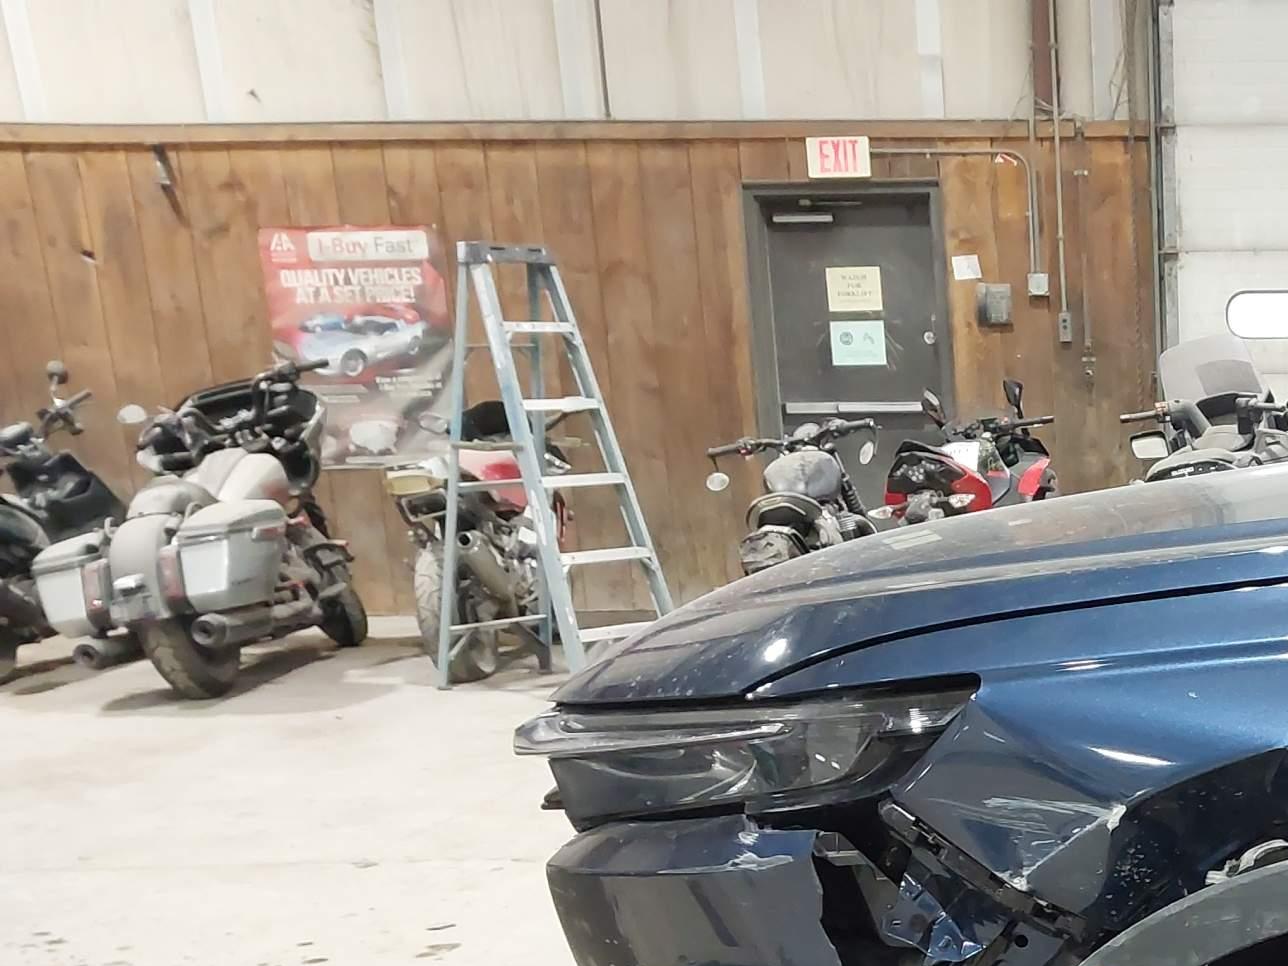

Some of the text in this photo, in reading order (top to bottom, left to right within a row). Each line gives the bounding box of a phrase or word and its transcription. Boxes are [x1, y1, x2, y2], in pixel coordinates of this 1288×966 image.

[818, 139, 859, 173] EXIT
[373, 235, 414, 253] Fast
[279, 267, 423, 287] QUALITY VEHICLES
[296, 284, 417, 304] AT A SET PRICE!
